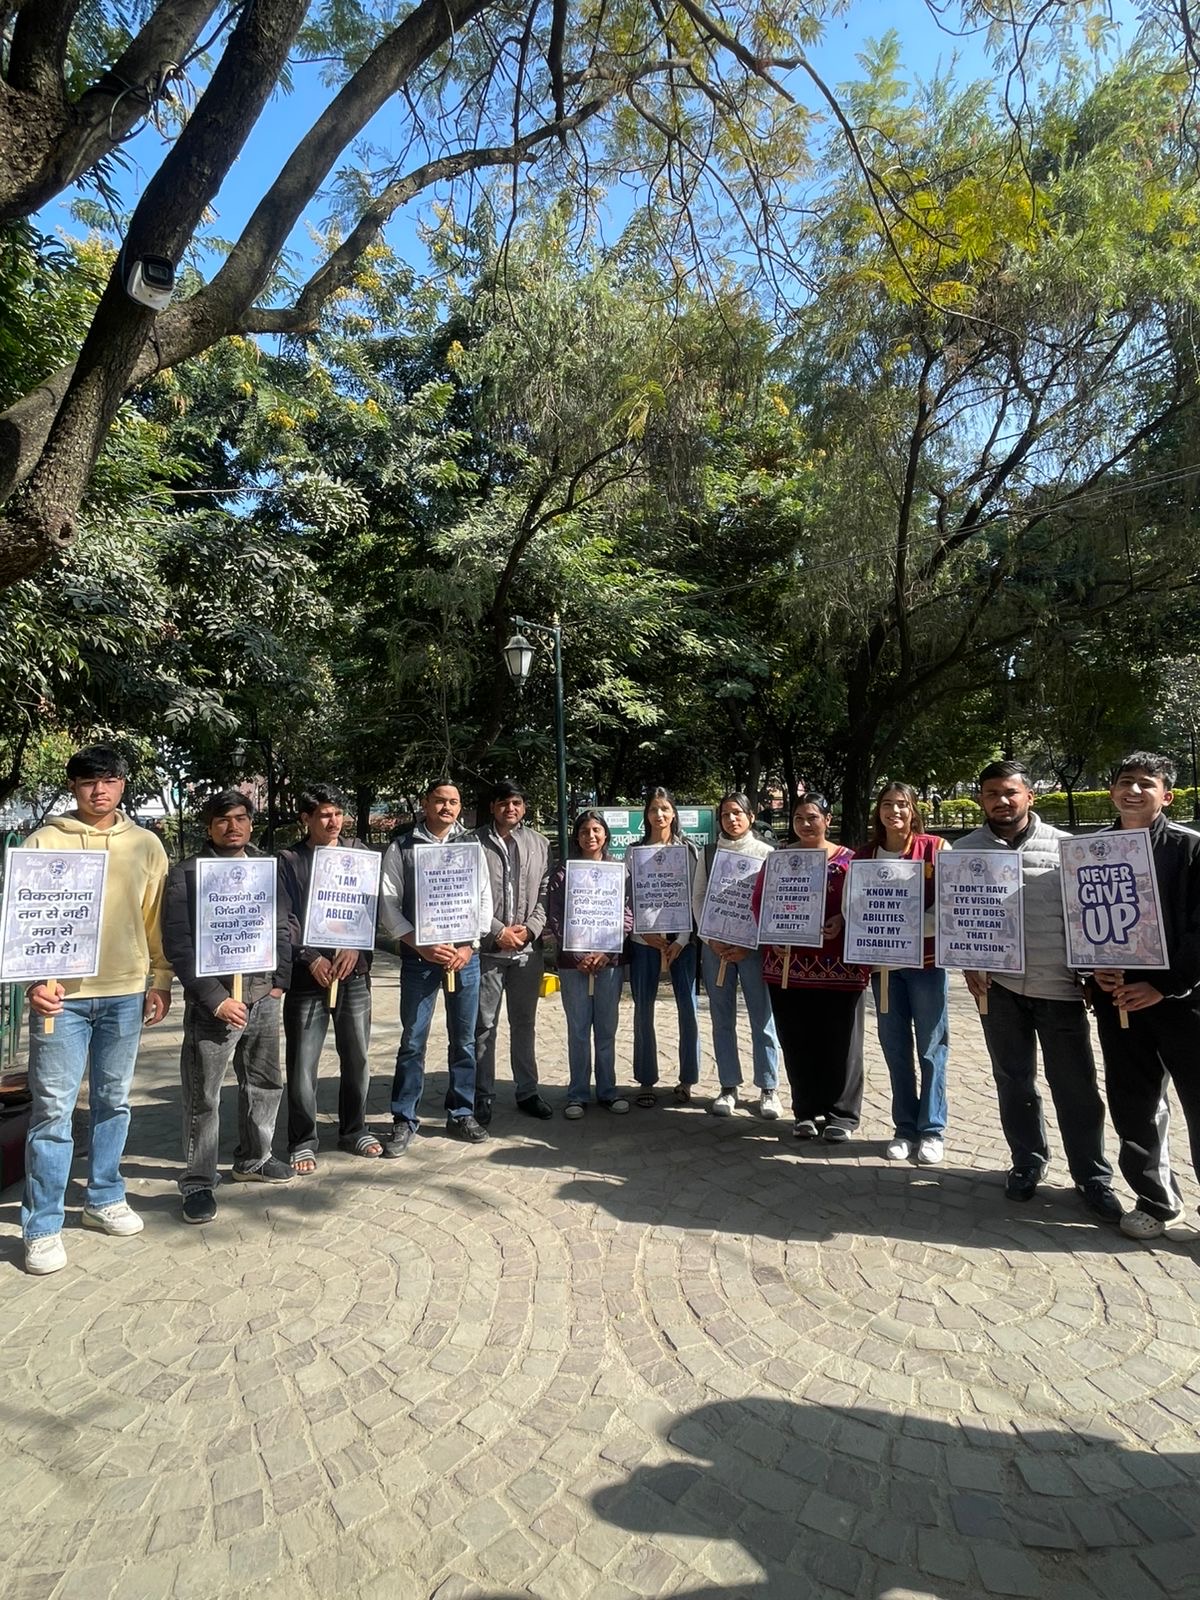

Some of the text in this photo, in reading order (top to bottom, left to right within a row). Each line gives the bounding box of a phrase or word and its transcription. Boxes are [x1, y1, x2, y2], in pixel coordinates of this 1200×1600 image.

[1079, 866, 1132, 883] NEVER
[343, 876, 357, 886] AM
[862, 888, 909, 897] "KNOW ME
[959, 885, 984, 893] DON'T
[986, 885, 1008, 894] HAVE
[1081, 881, 1136, 904] GIVE
[18, 889, 93, 901] विकलांगता
[254, 891, 266, 901] की
[317, 890, 371, 905] DIFFERENTLY
[955, 896, 969, 904] EYE
[248, 905, 260, 914] को
[868, 901, 901, 909] FOR MY
[18, 909, 41, 919] तन
[46, 907, 58, 919] से
[325, 908, 359, 920] ABLED."
[972, 908, 981, 916] IT
[983, 909, 1006, 917] DOES
[210, 918, 264, 929] बचाओ उनके
[570, 918, 580, 926] को
[957, 919, 1001, 928] NOT MEAN
[1085, 903, 1137, 942] UP
[32, 924, 73, 936] मन से
[867, 926, 901, 935] NOT MY
[214, 931, 261, 942] संग जीवन
[966, 931, 993, 940] THAT I
[25, 941, 55, 955] होती
[856, 939, 912, 949] DISABILITY."
[949, 942, 1010, 953] LACK VISION."
